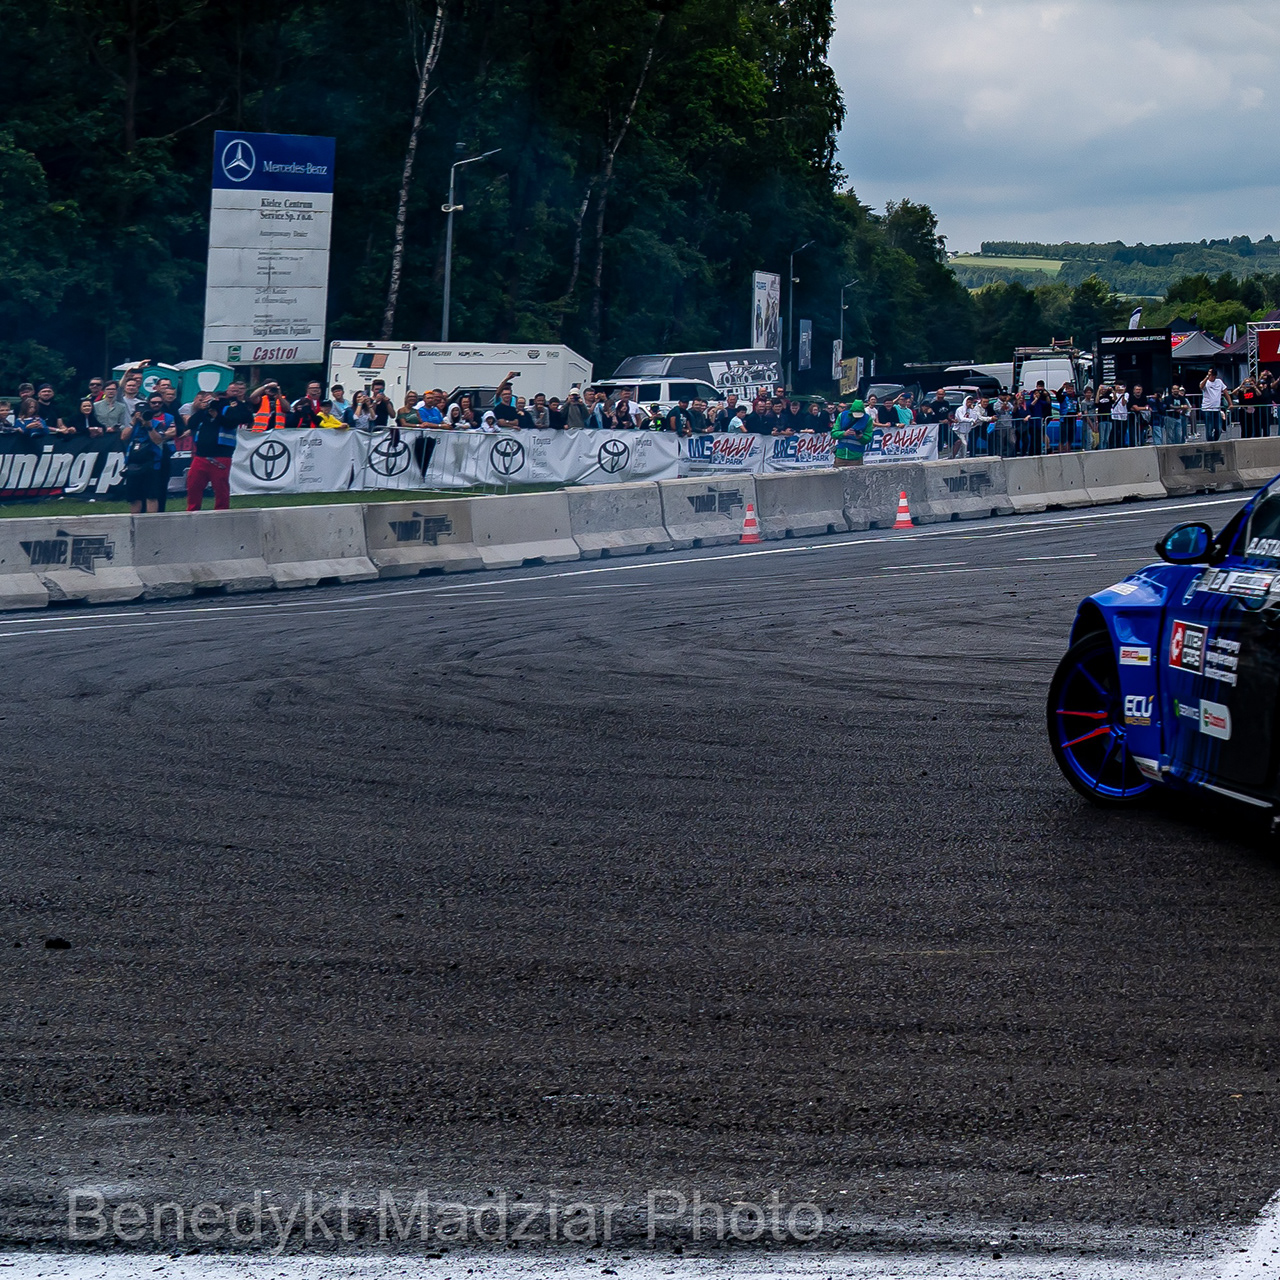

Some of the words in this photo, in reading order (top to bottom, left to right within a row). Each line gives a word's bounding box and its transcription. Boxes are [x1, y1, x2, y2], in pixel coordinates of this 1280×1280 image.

[262, 161, 328, 175] Mercedes-Benz
[260, 198, 282, 209] Kielce
[283, 199, 313, 209] Centrum
[260, 211, 284, 221] Service
[253, 346, 299, 360] Castrol
[900, 447, 918, 455] PARK
[725, 457, 744, 466] PARK
[812, 454, 830, 462] PARK
[31, 539, 68, 565] DMP
[1124, 694, 1154, 718] ECU
